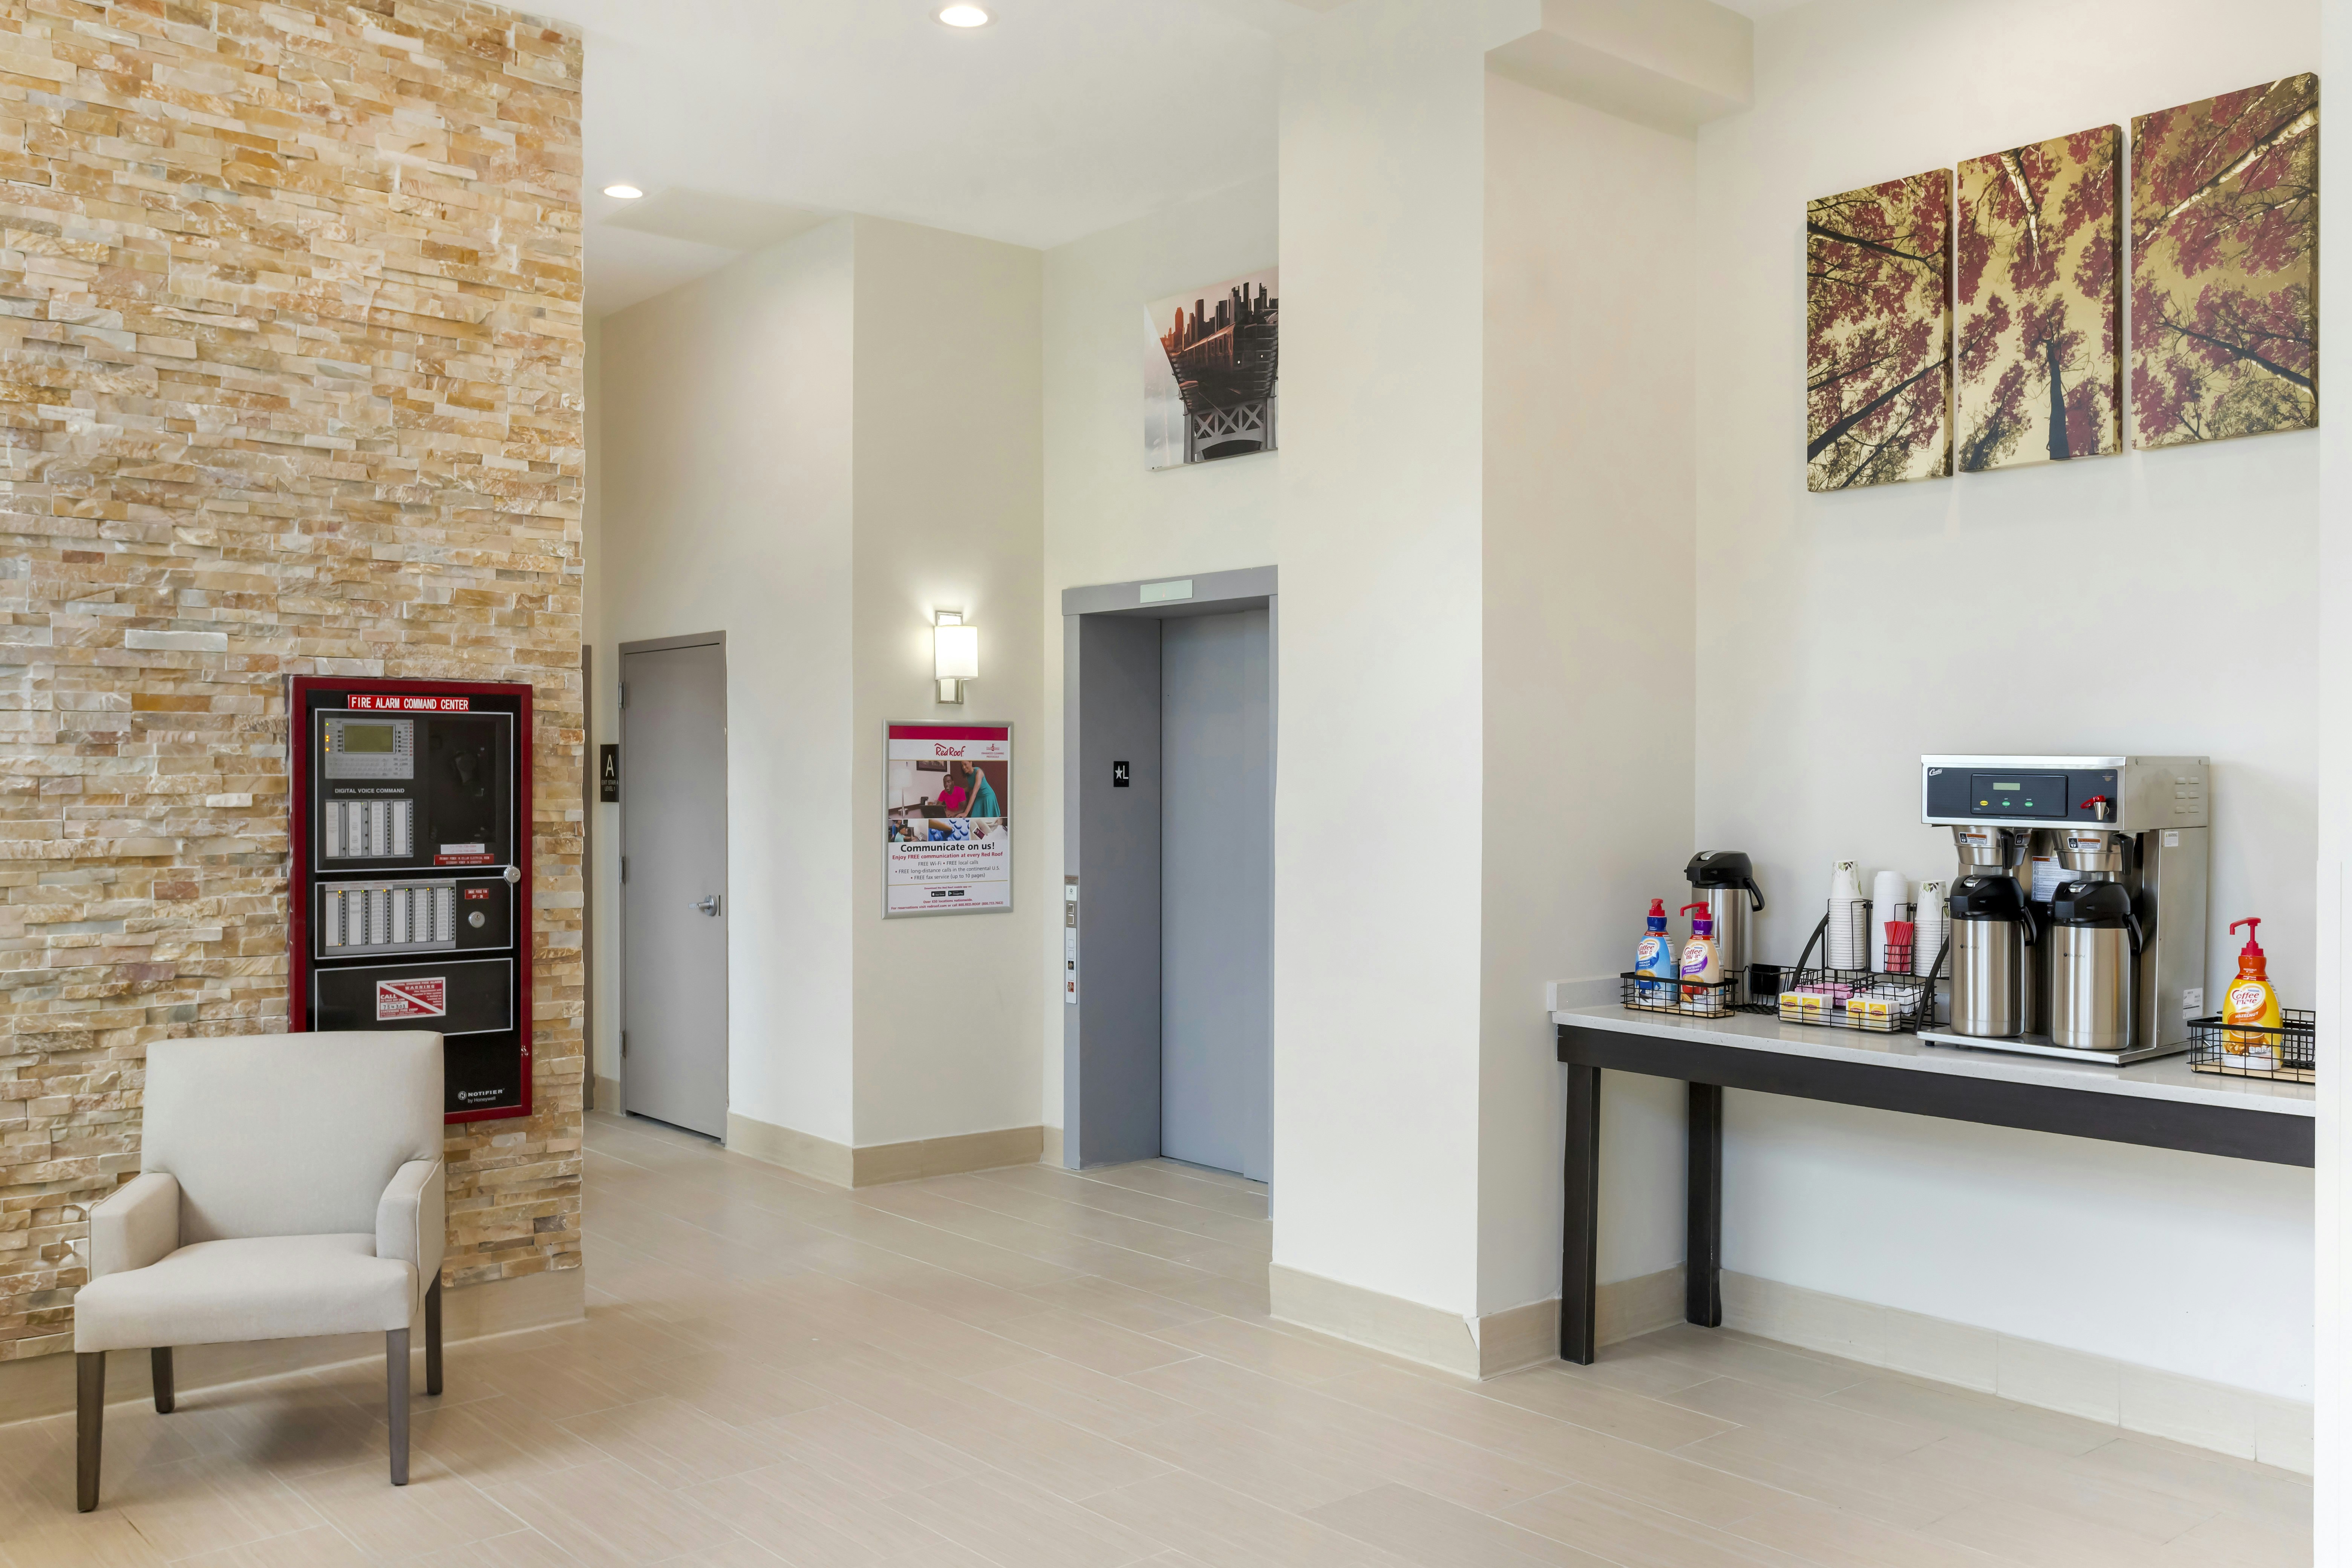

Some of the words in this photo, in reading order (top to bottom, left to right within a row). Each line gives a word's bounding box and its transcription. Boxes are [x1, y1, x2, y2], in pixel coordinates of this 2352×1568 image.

[352, 697, 371, 708] FIRE
[375, 697, 400, 709] ALARM
[404, 698, 436, 709] COMMAND
[441, 699, 468, 710] CENTER
[936, 747, 948, 756] Red
[949, 746, 966, 757] Roof
[605, 754, 614, 776] A
[900, 843, 965, 852] Communicate
[1684, 947, 1703, 956] Coffee
[2232, 990, 2259, 1000] Coffee
